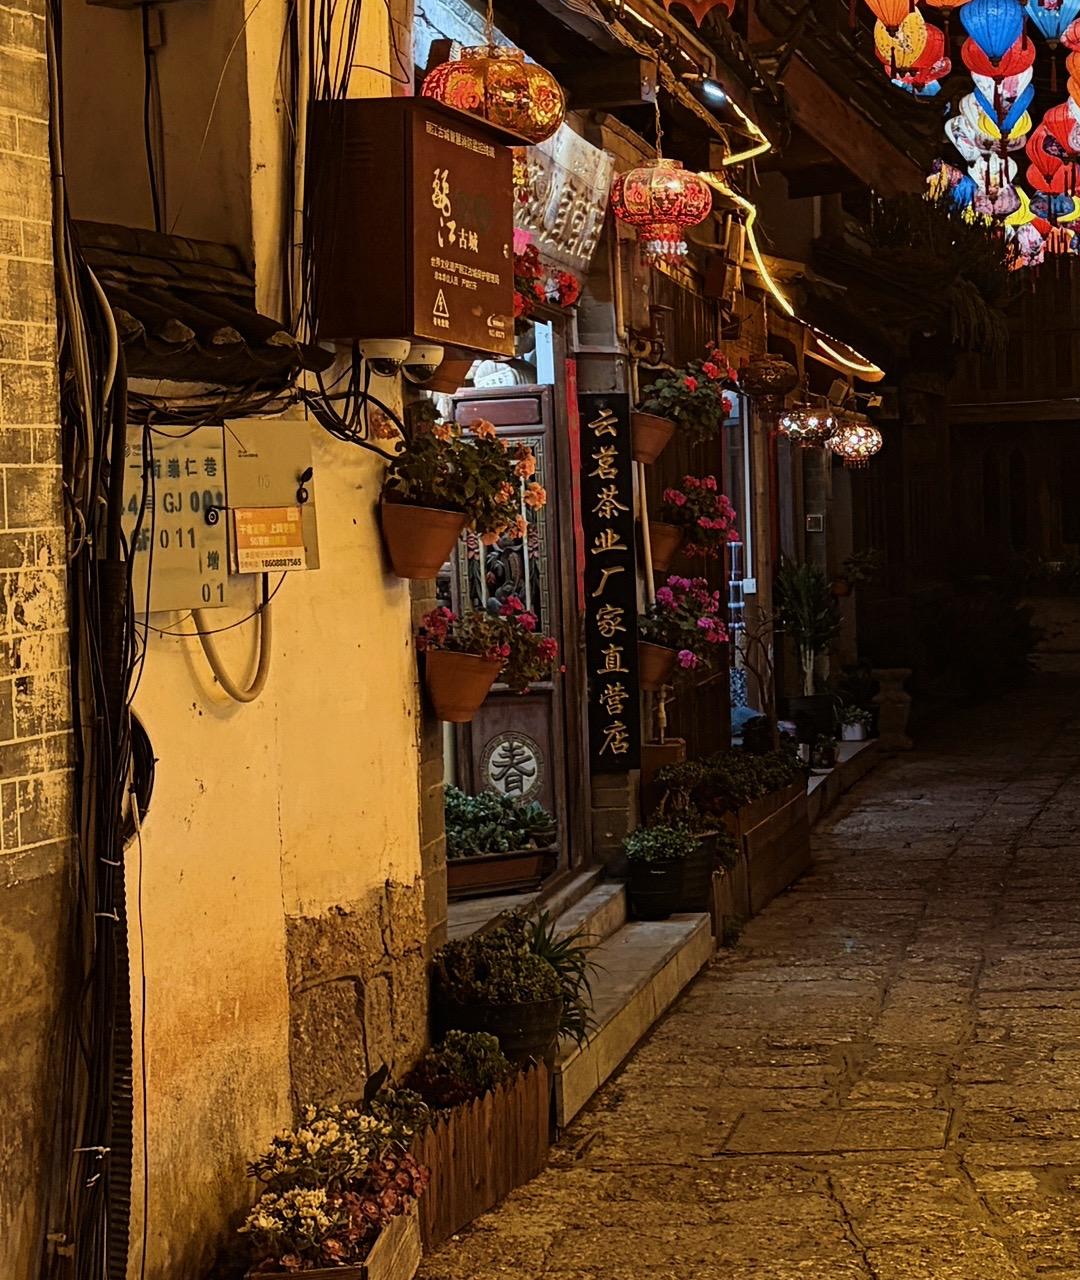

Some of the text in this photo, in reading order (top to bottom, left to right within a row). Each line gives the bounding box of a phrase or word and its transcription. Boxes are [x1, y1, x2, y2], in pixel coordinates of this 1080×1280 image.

[164, 491, 183, 514] GJ
[160, 527, 196, 550] 011
[201, 583, 225, 603] 01
[588, 409, 630, 756] 云茗茶业厂家直营店
[491, 742, 536, 794] 春
